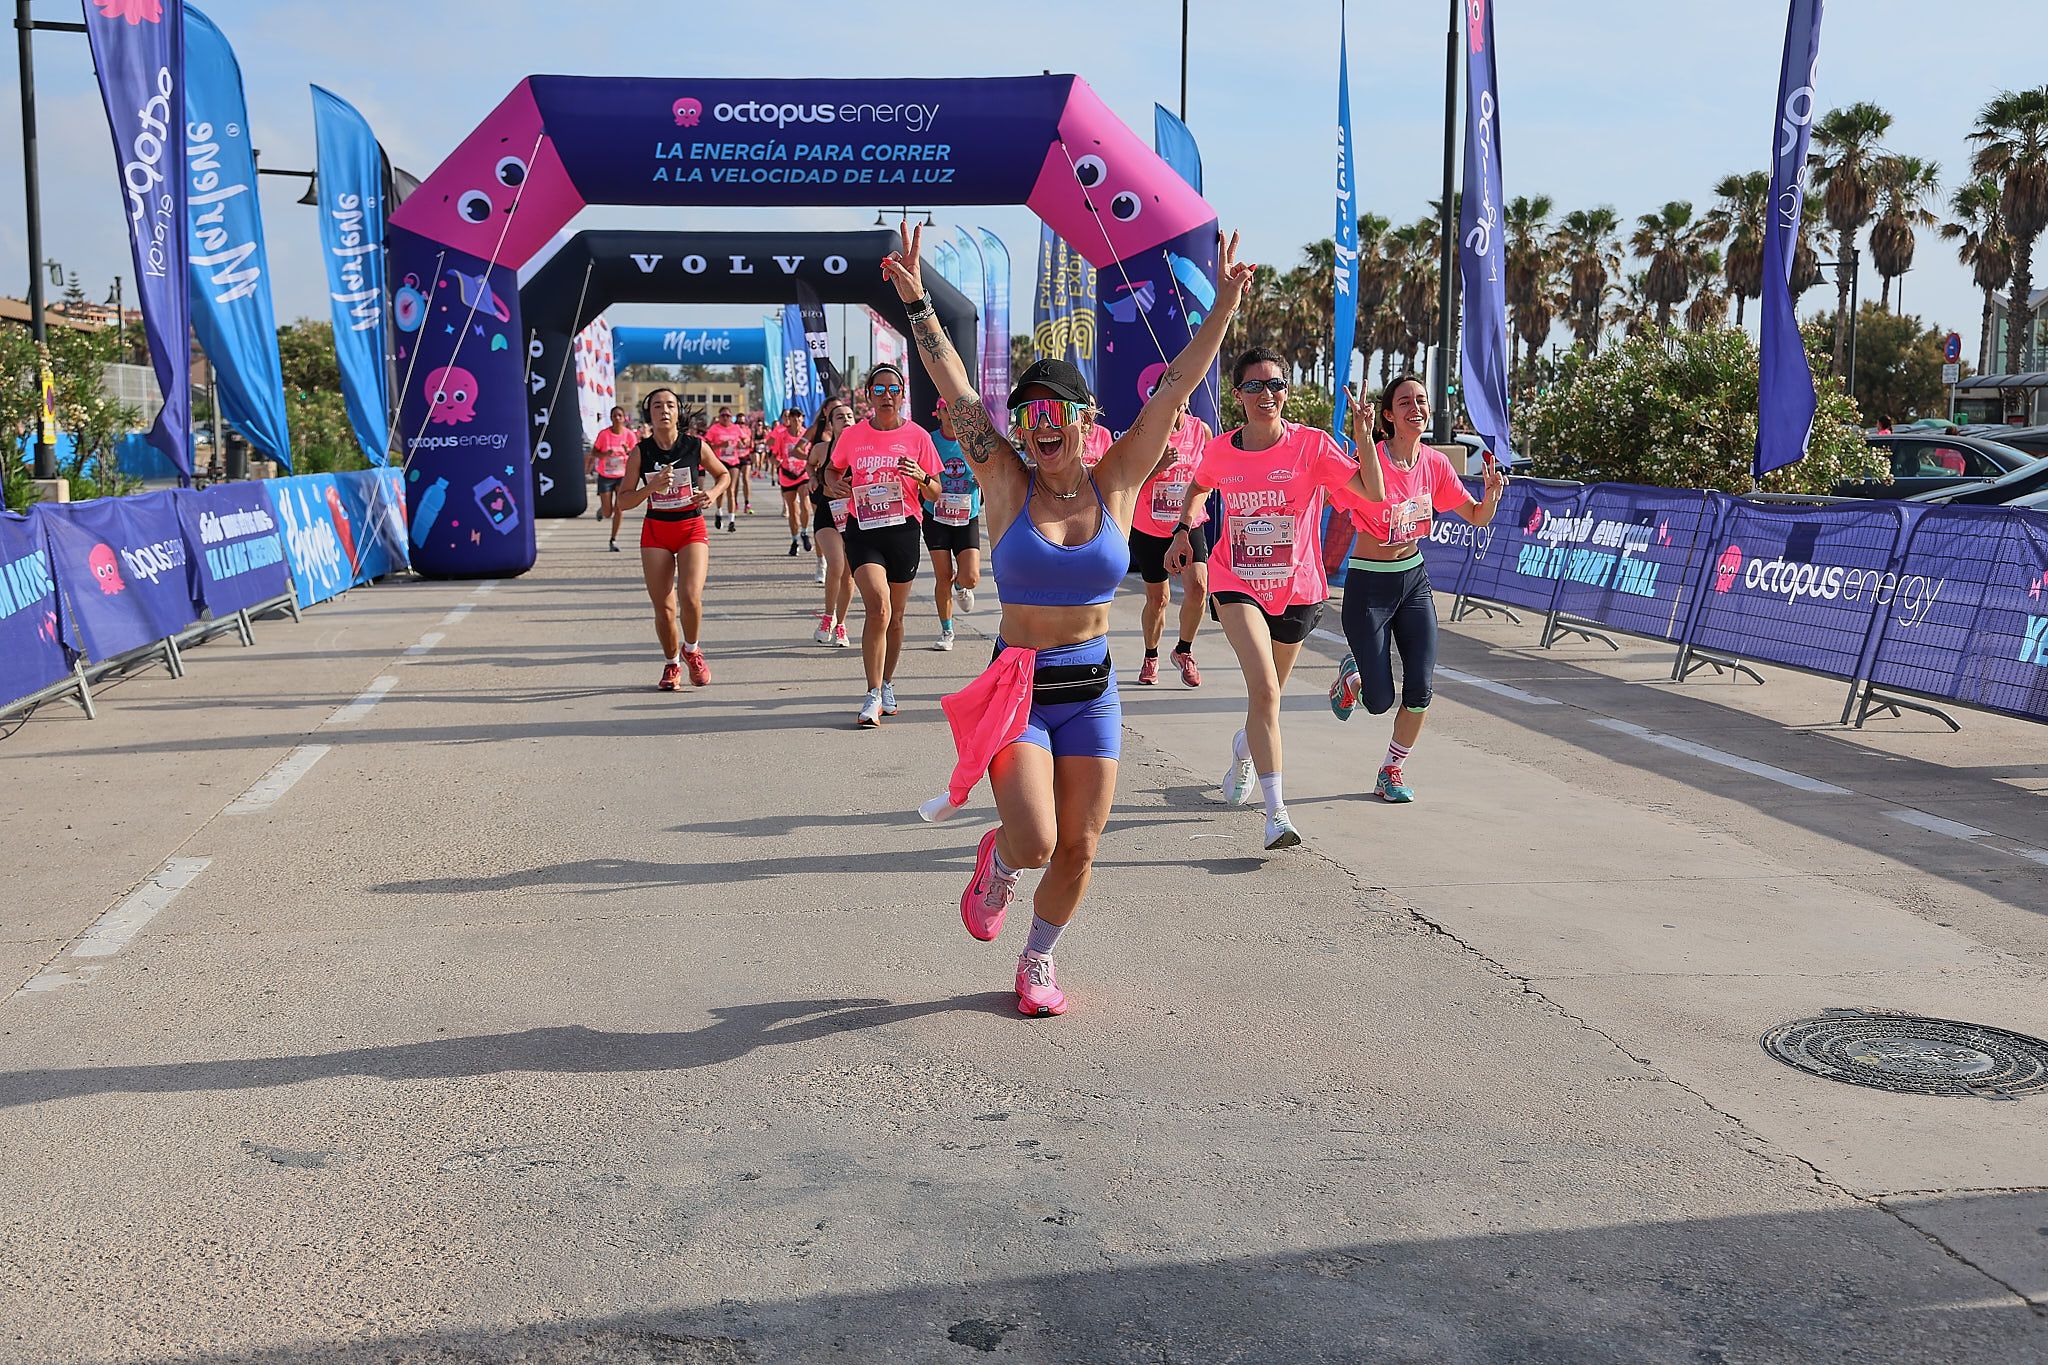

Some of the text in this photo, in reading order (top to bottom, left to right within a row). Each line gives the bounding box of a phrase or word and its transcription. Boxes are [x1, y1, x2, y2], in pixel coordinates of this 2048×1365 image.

[713, 100, 940, 132] octopus energy
[655, 139, 951, 161] LA ENERGÍA PARA CORRER
[653, 168, 955, 184] A LA VELOCIDAD DE LA LUZ
[630, 253, 849, 275] VOLVO
[663, 329, 731, 360] Marlene
[530, 339, 555, 497] VOLVO
[459, 433, 509, 449] energy
[871, 502, 890, 512] 016
[1166, 499, 1183, 507] 016
[1226, 489, 1287, 510] CARRERA
[1401, 521, 1417, 534] 016
[1246, 545, 1273, 556] 016
[1612, 556, 1661, 598] FINAL
[1745, 556, 1945, 629] octopus energy
